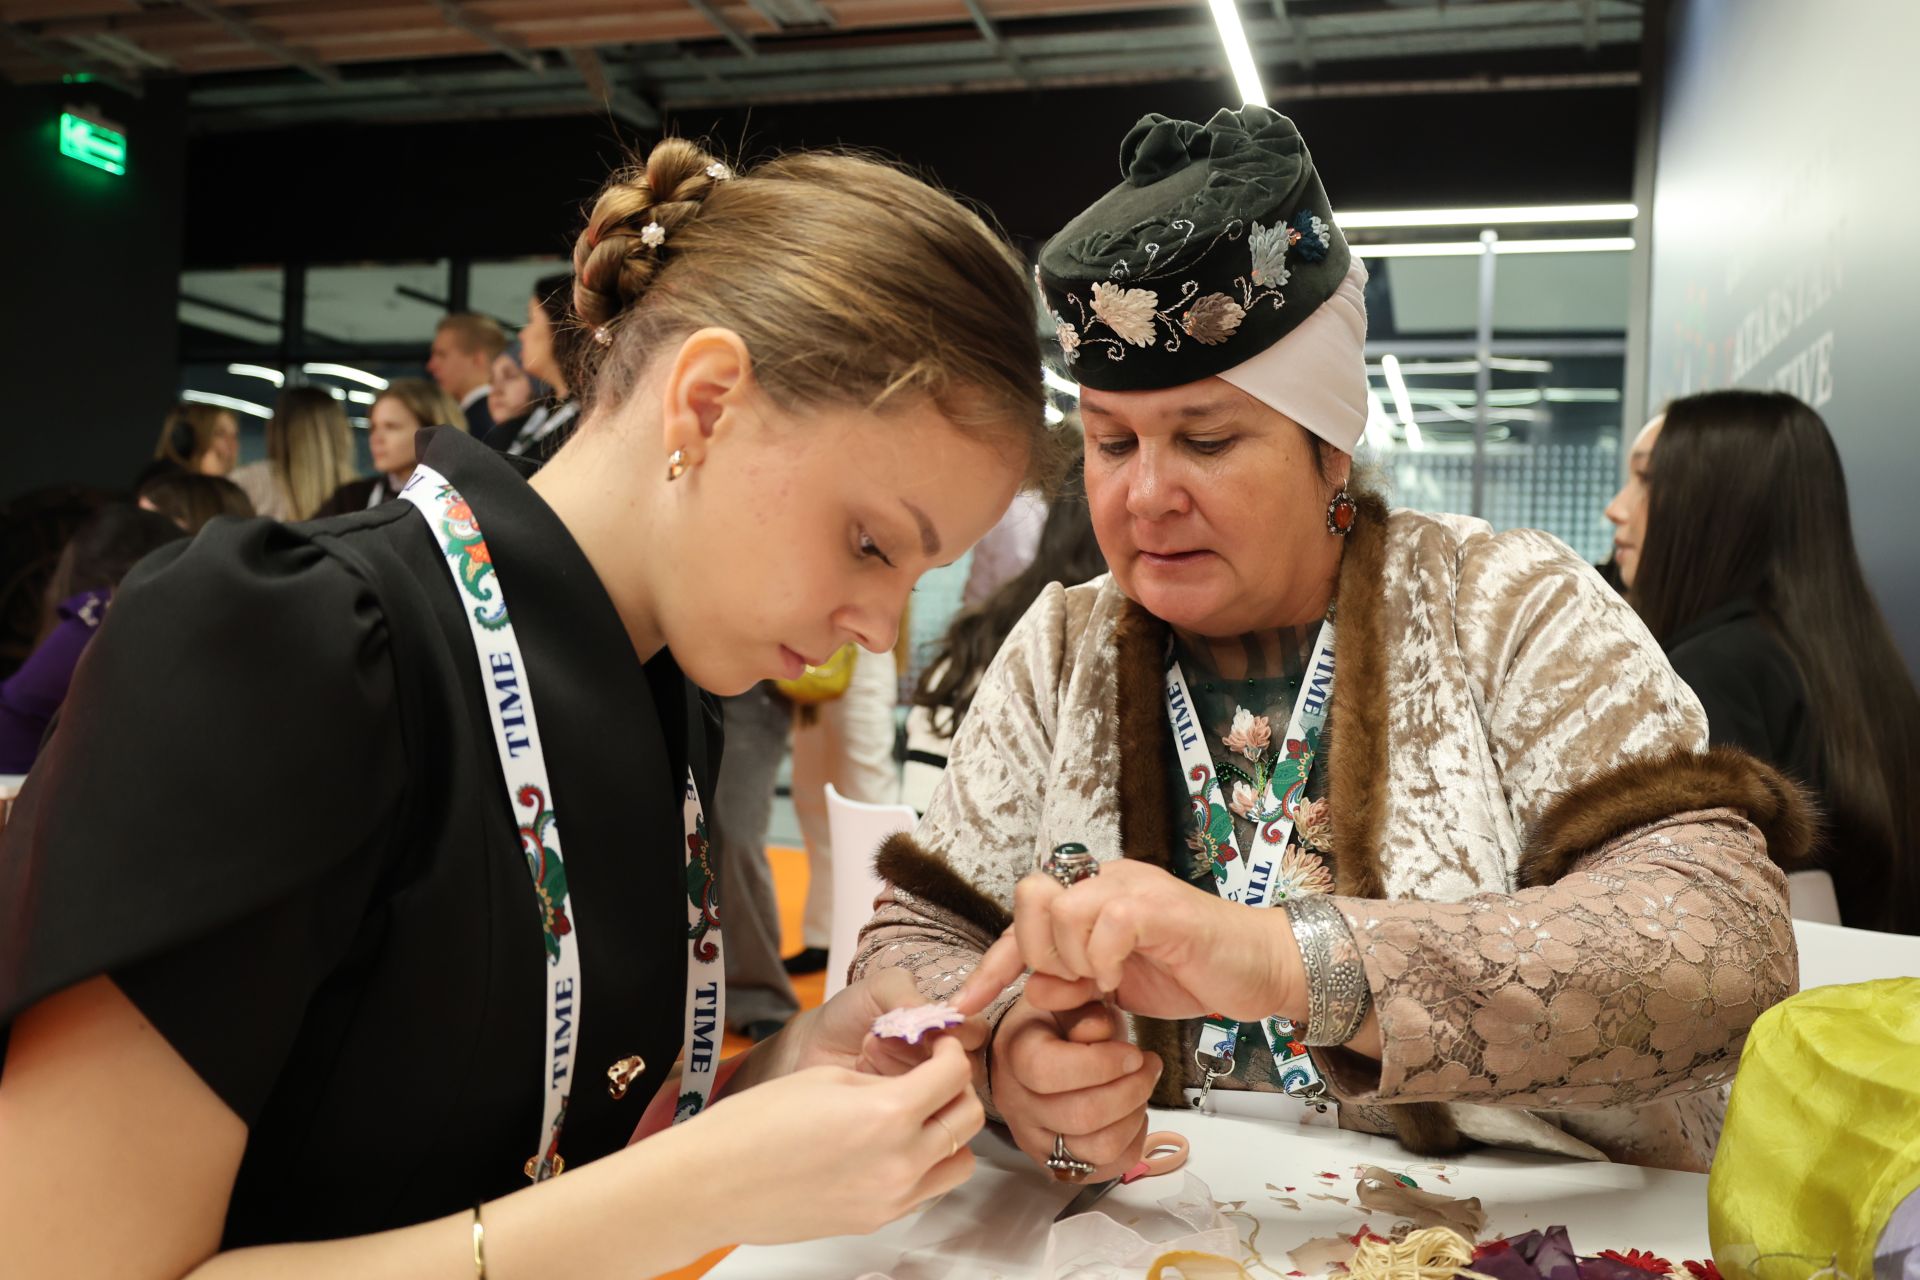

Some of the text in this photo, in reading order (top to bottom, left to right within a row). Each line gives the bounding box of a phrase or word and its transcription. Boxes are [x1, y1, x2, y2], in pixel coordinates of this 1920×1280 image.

[489, 652, 531, 758] TIME
[1167, 681, 1198, 751] TIME
[1303, 648, 1335, 717] TIME
[552, 977, 573, 1089] TIME
[691, 981, 717, 1073] TIME
